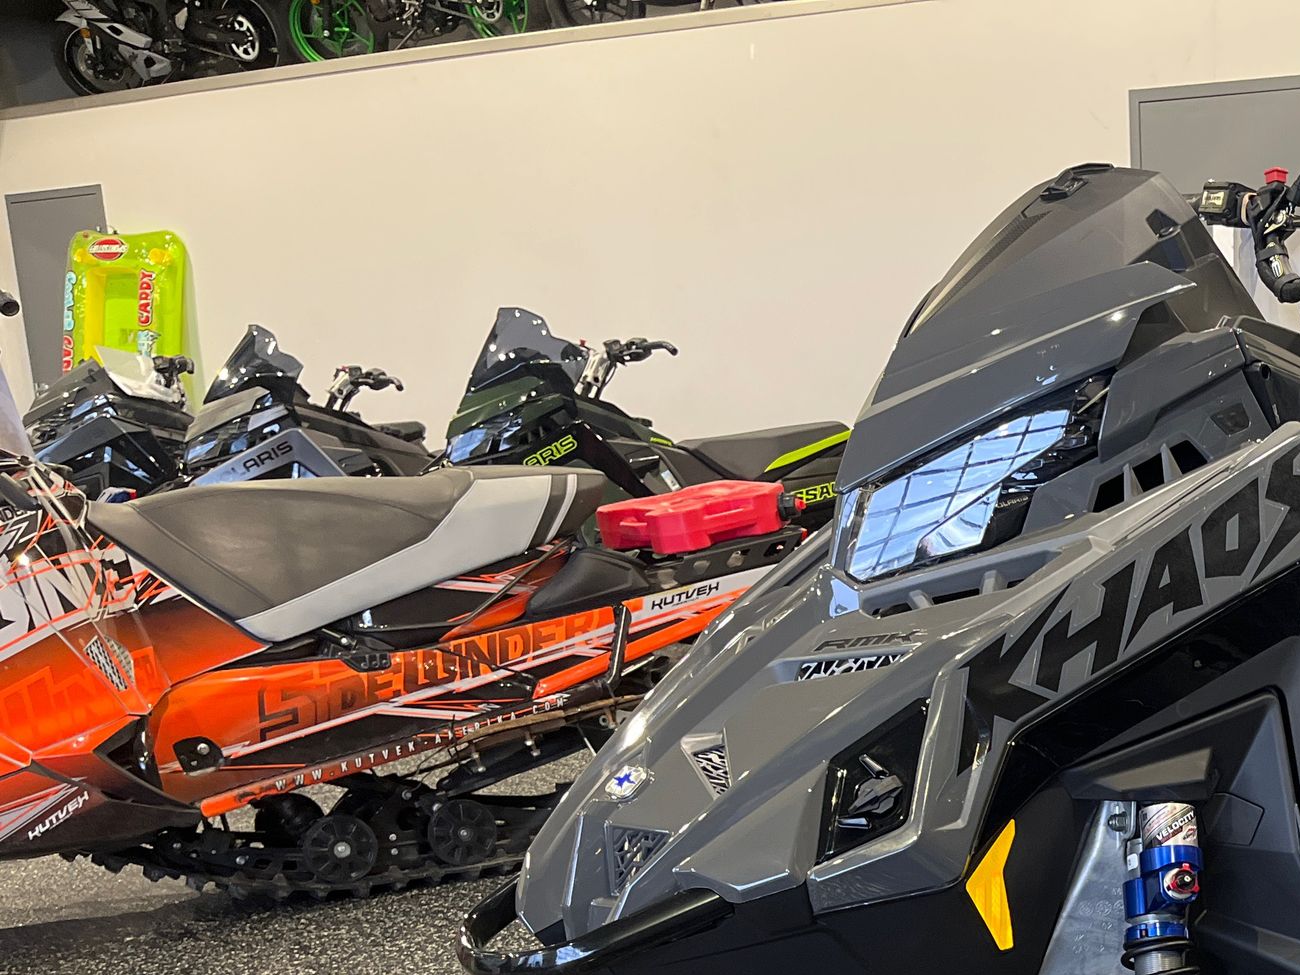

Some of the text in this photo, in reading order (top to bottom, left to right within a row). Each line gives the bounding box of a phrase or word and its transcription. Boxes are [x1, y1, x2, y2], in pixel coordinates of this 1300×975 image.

[137, 269, 155, 327] CADDY
[813, 629, 921, 652] RMK
[1155, 810, 1195, 841] VELOCITY
